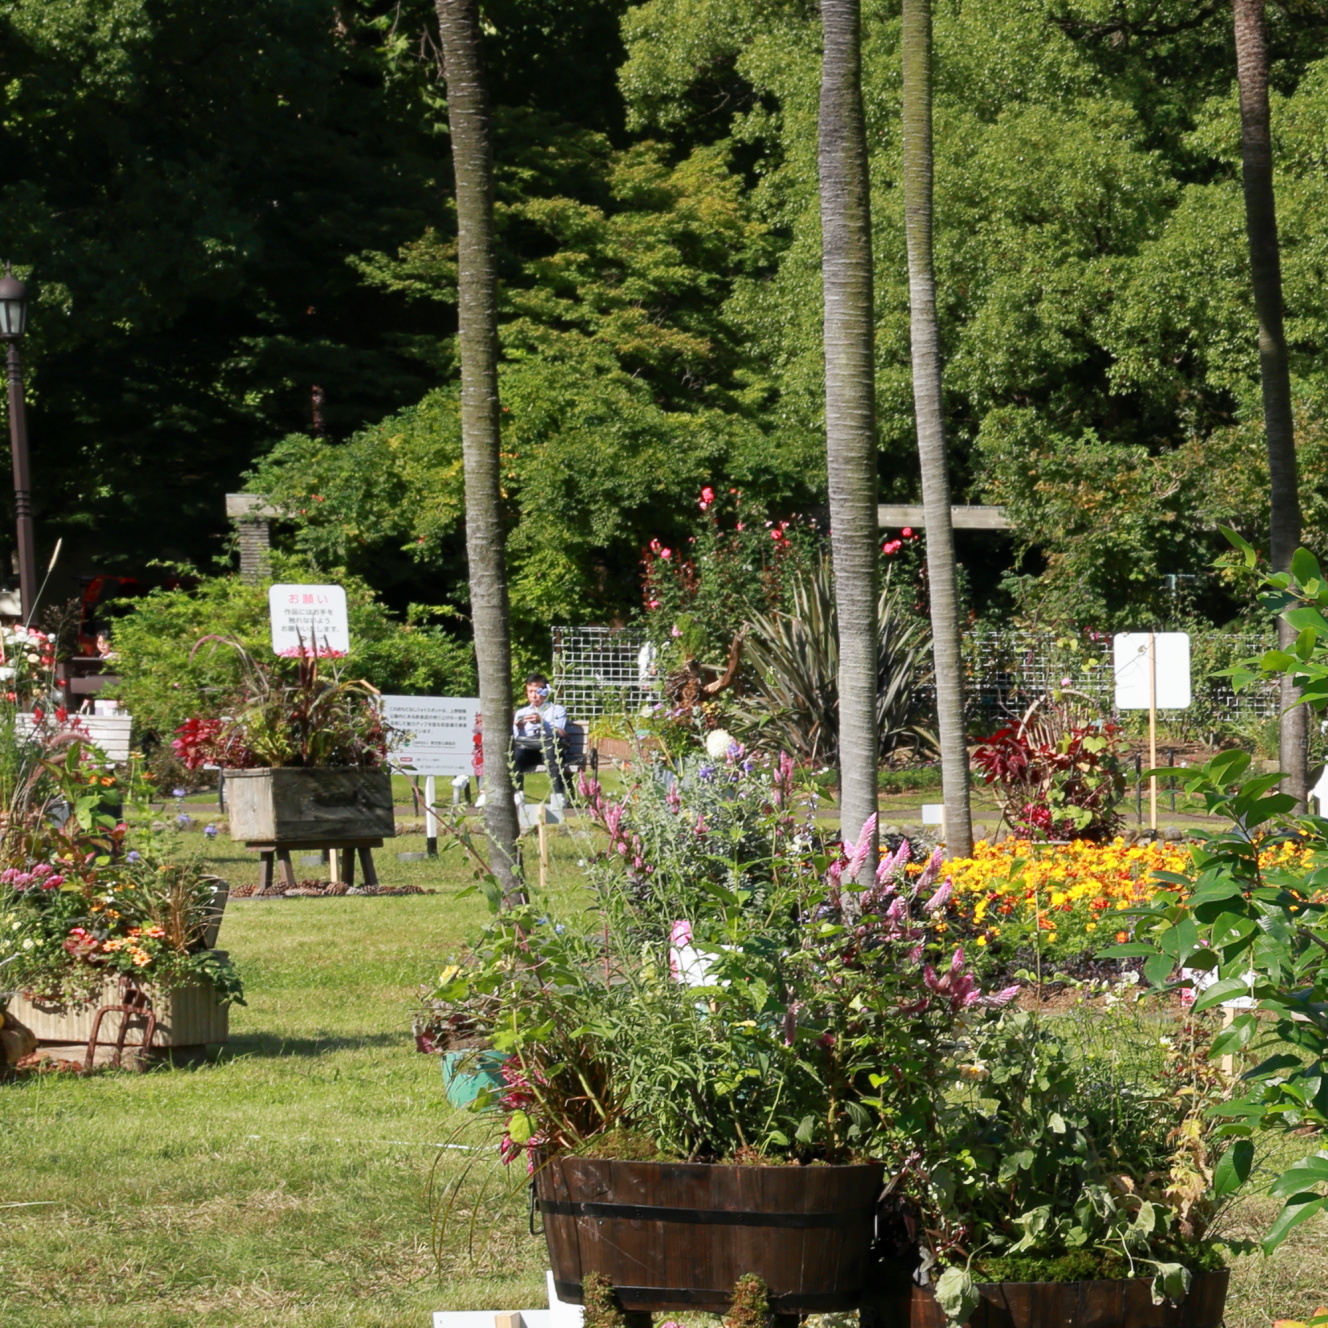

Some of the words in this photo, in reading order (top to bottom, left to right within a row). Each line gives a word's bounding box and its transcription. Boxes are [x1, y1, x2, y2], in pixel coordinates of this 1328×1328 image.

[288, 594, 328, 604] お願い
[284, 608, 334, 616] 作品にはお手を
